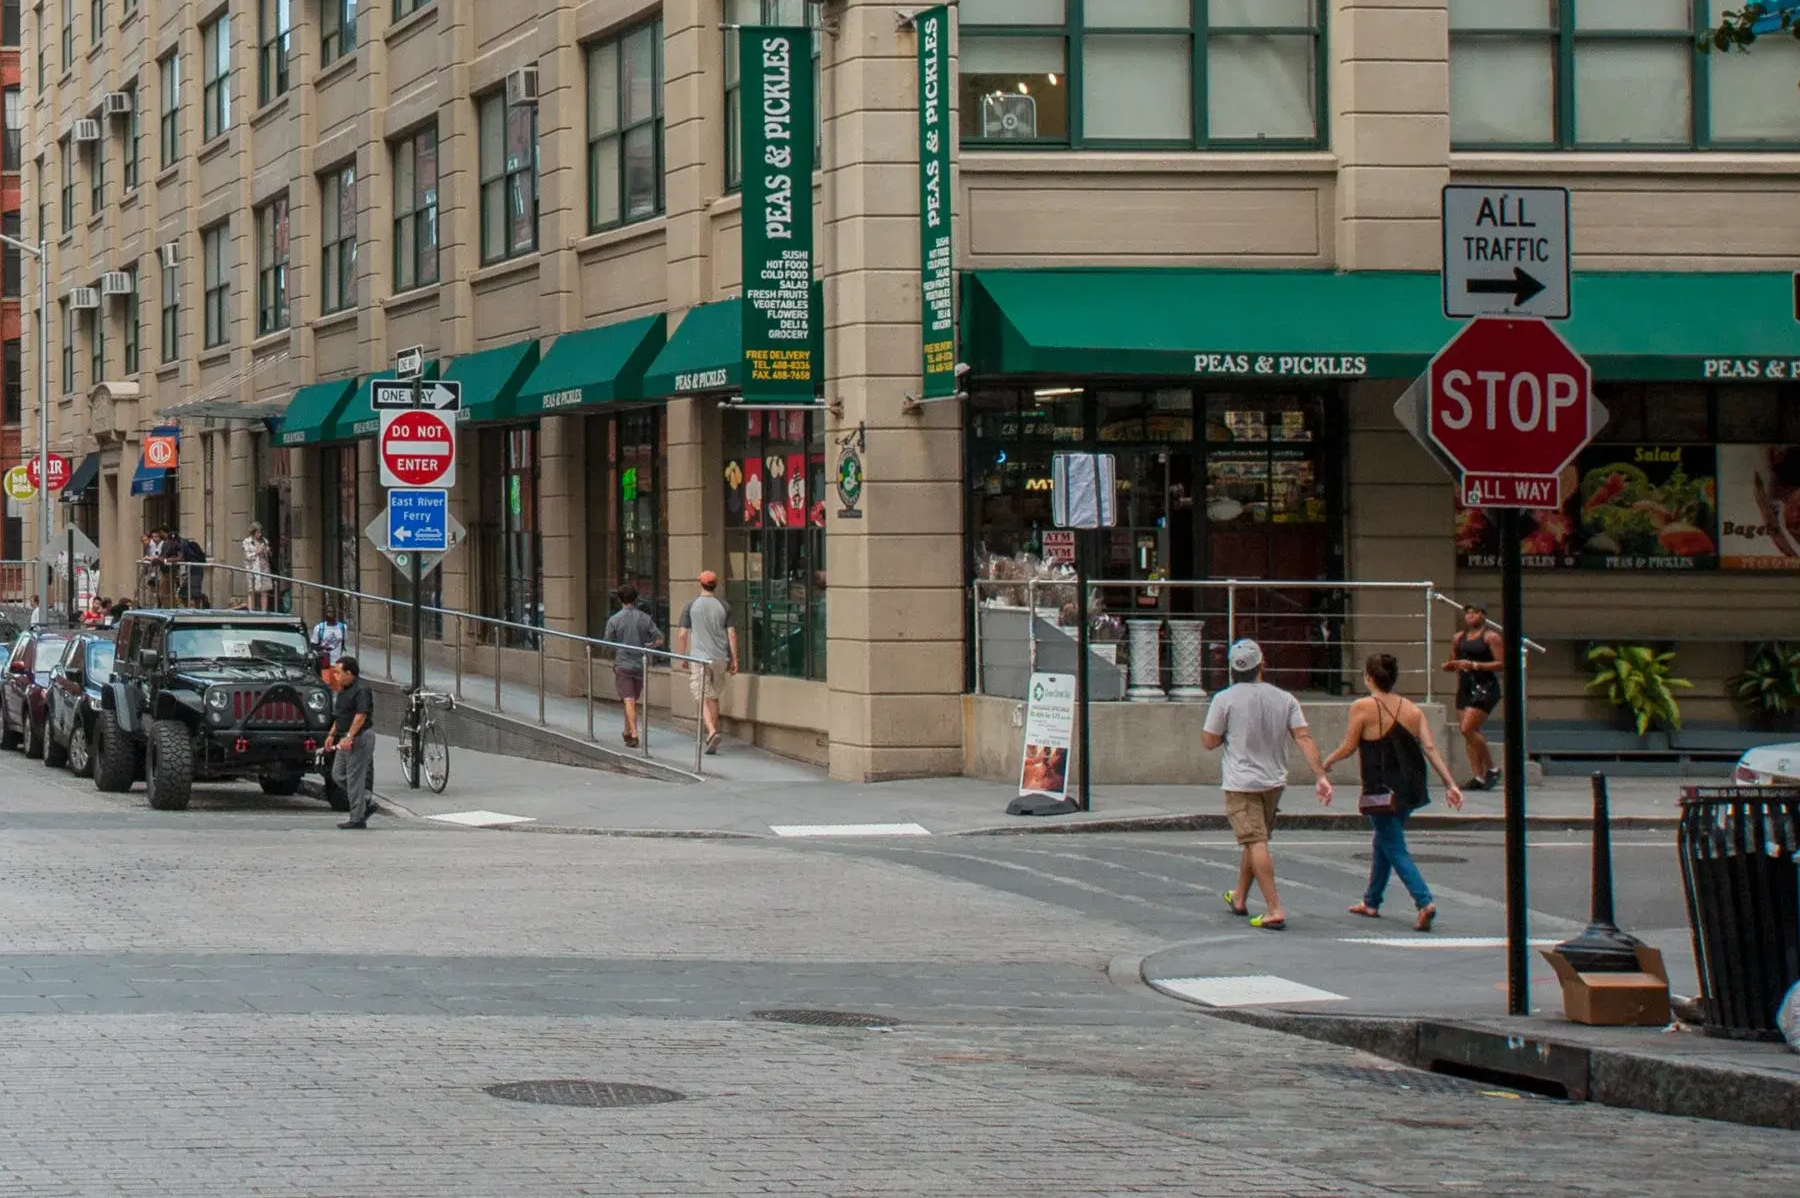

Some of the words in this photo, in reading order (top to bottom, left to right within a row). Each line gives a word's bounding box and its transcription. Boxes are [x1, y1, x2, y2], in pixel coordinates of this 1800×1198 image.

[925, 17, 938, 126] PICKLES
[763, 37, 790, 140] PICKLES
[925, 129, 939, 153] &
[764, 145, 791, 168] &
[926, 159, 940, 229] PEAS
[765, 174, 792, 239] PEAS
[1475, 196, 1536, 227] ALL
[782, 251, 808, 260] SUSHI
[1463, 237, 1548, 262] TRAFFIC
[766, 260, 783, 270] HOT
[785, 260, 808, 270] FOOD
[761, 270, 784, 279] COLD
[785, 270, 808, 279] FOOD
[779, 280, 808, 289] SALAD
[748, 290, 777, 299] FRESH
[778, 290, 808, 299] FRUITS
[754, 300, 808, 309] VEGETABLES
[767, 310, 808, 319] FLOWERS
[780, 320, 800, 329] DELI
[801, 320, 808, 329] &
[768, 330, 808, 339] GROCERY
[746, 350, 769, 360] FREE
[770, 350, 810, 360] DELIVERY
[1194, 354, 1249, 373] PEAS
[1254, 355, 1275, 374] &
[1279, 355, 1367, 375] PICKLES
[1703, 358, 1759, 378] PEAS
[1765, 359, 1786, 379] &
[675, 373, 692, 391] PEAS
[691, 373, 698, 389] &
[699, 368, 727, 388] PICKLES
[381, 390, 406, 403] ONE
[1440, 369, 1579, 432] STOP
[391, 425, 410, 438] DO
[417, 426, 443, 438] NOT
[1634, 447, 1682, 462] Salad
[397, 458, 438, 471] ENTER
[1471, 481, 1506, 500] ALL
[1515, 481, 1551, 501] WAY
[392, 497, 413, 506] East
[417, 497, 444, 506] River
[403, 511, 432, 523] Ferry
[1045, 532, 1071, 542] ATM
[1046, 548, 1071, 558] ATM
[1468, 554, 1495, 567] PEAS
[1606, 555, 1633, 568] PEAS
[1635, 555, 1647, 568] &
[1649, 555, 1694, 568] PICKLES
